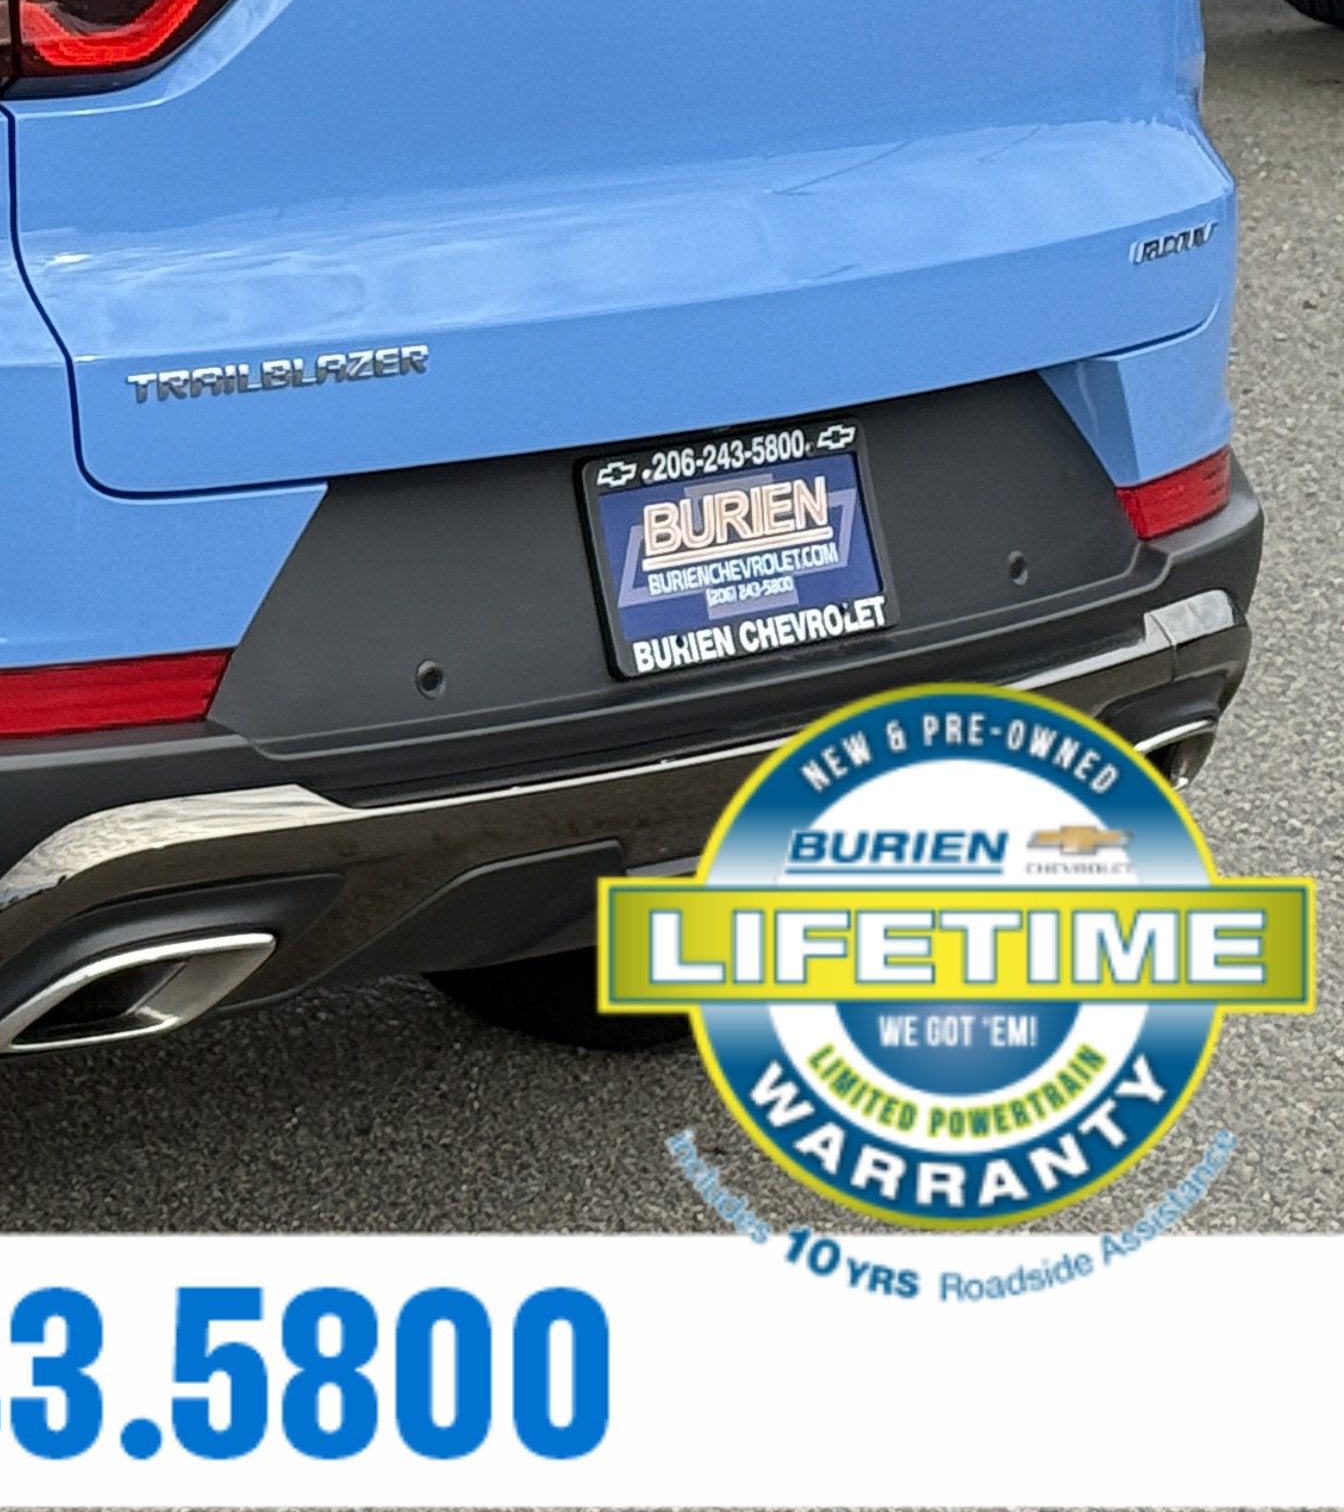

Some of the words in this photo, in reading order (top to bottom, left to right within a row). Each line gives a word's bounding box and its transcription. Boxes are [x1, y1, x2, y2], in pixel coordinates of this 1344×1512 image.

[126, 344, 429, 404] TRAILBLAZER
[643, 476, 829, 556] BURIEN
[648, 542, 839, 595] BURIENCHEVROLET.COM
[633, 629, 735, 674] BURIEN
[739, 596, 886, 654] CHEVROLET
